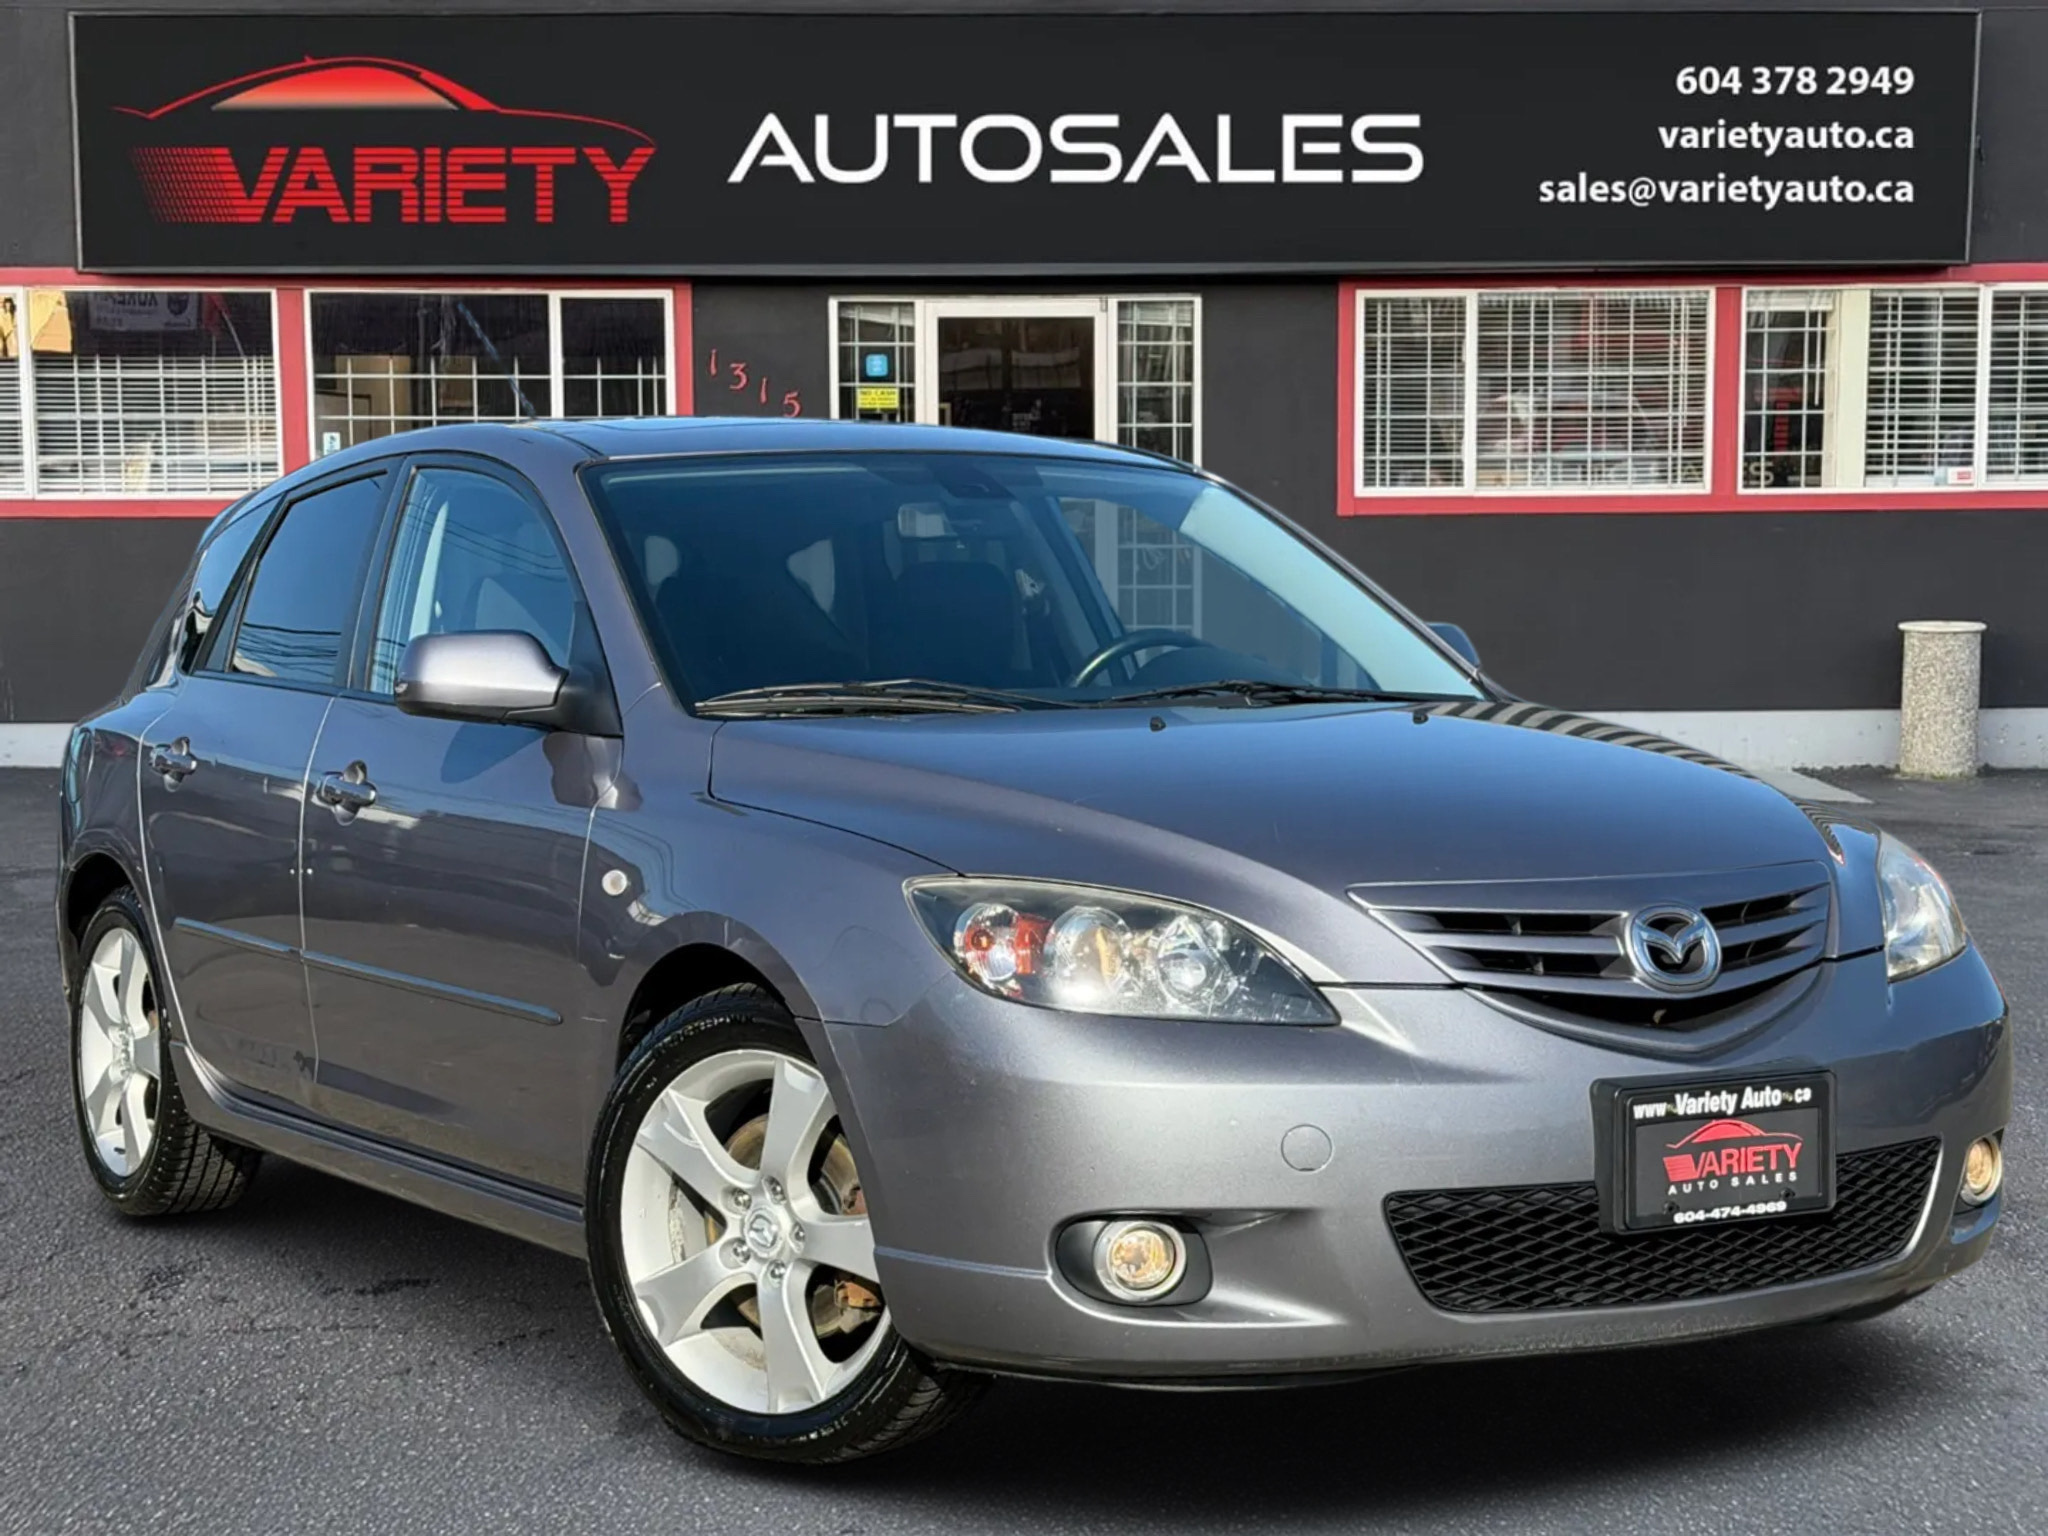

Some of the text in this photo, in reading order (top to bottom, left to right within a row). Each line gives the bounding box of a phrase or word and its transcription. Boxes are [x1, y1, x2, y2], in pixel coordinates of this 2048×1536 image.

[1676, 66, 1915, 95] 604 378 2949
[727, 112, 1424, 184] AUTOSALES
[1658, 118, 1914, 157] varietyauto.ca
[136, 146, 656, 224] VARIETY
[1539, 171, 1914, 211] sales@varietyauto.ca
[1663, 1142, 1802, 1182] VARIETY
[1668, 1171, 1797, 1195] AUTO SALES
